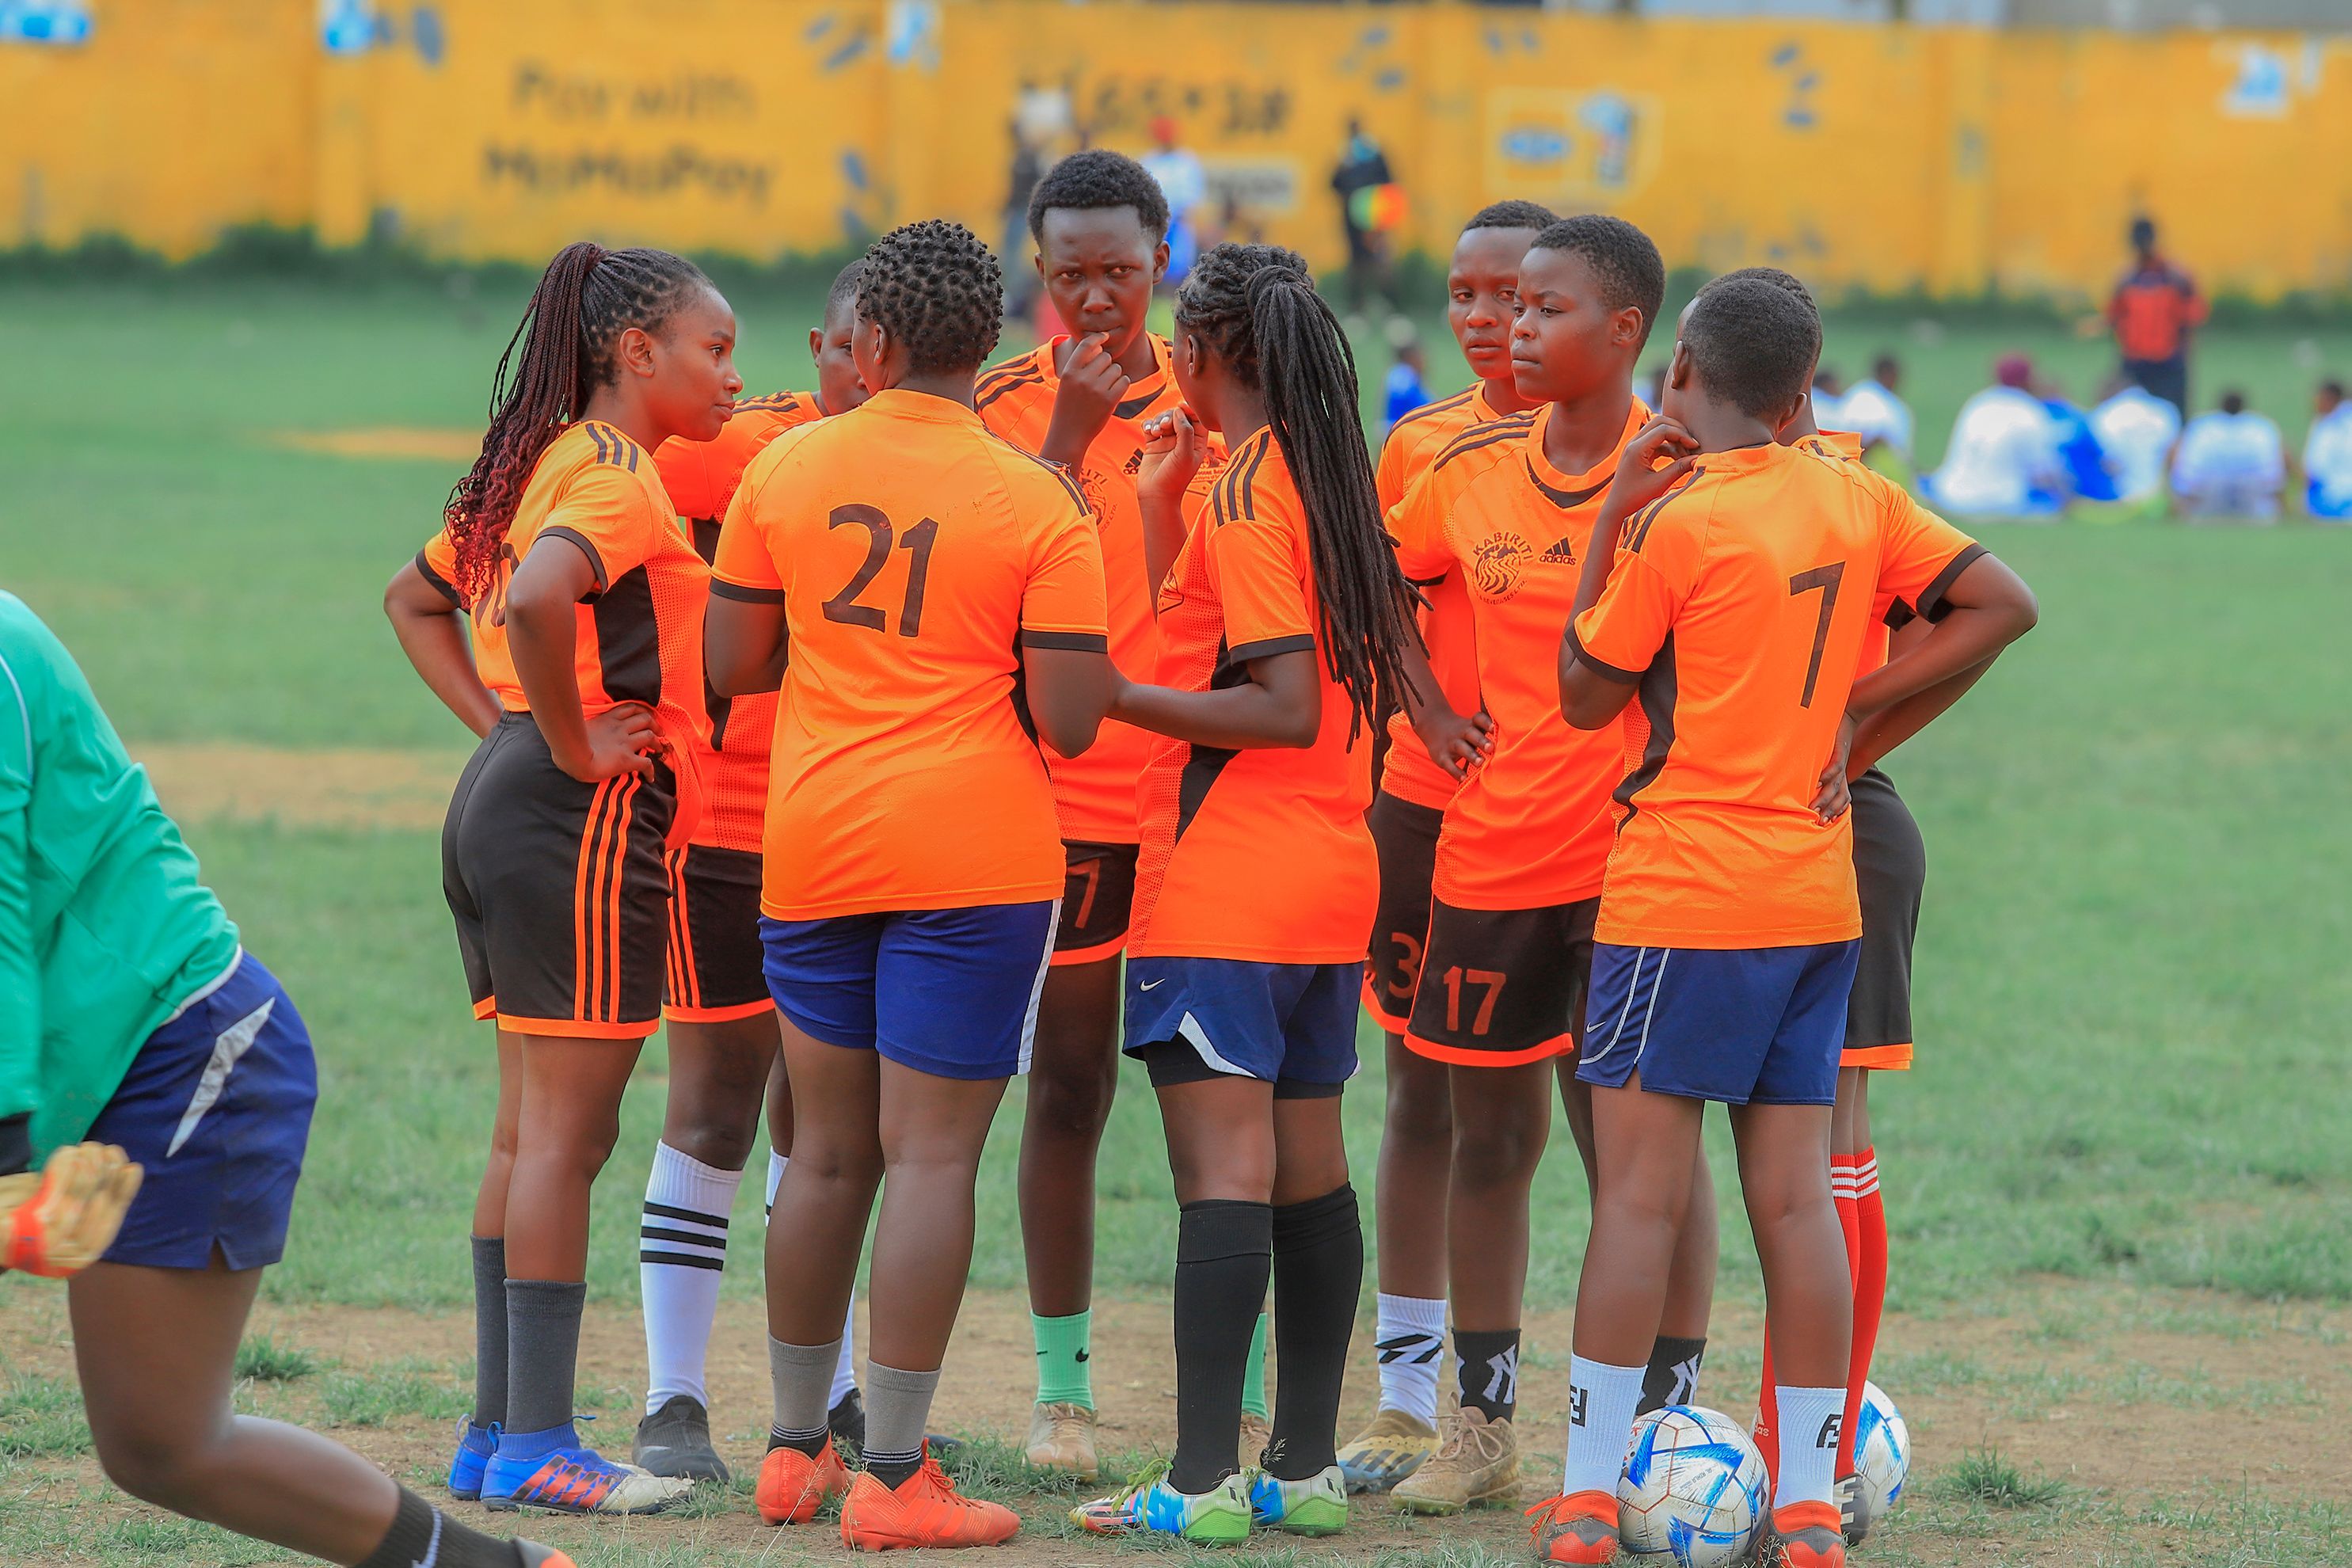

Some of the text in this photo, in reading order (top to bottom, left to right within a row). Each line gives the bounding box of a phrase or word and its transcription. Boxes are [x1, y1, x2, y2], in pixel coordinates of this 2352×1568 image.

[821, 504, 939, 637] 21
[1473, 532, 1534, 560] KABIRITI
[1539, 554, 1577, 565] adidas
[1789, 560, 1846, 710] 7
[1443, 965, 1506, 1036] 17
